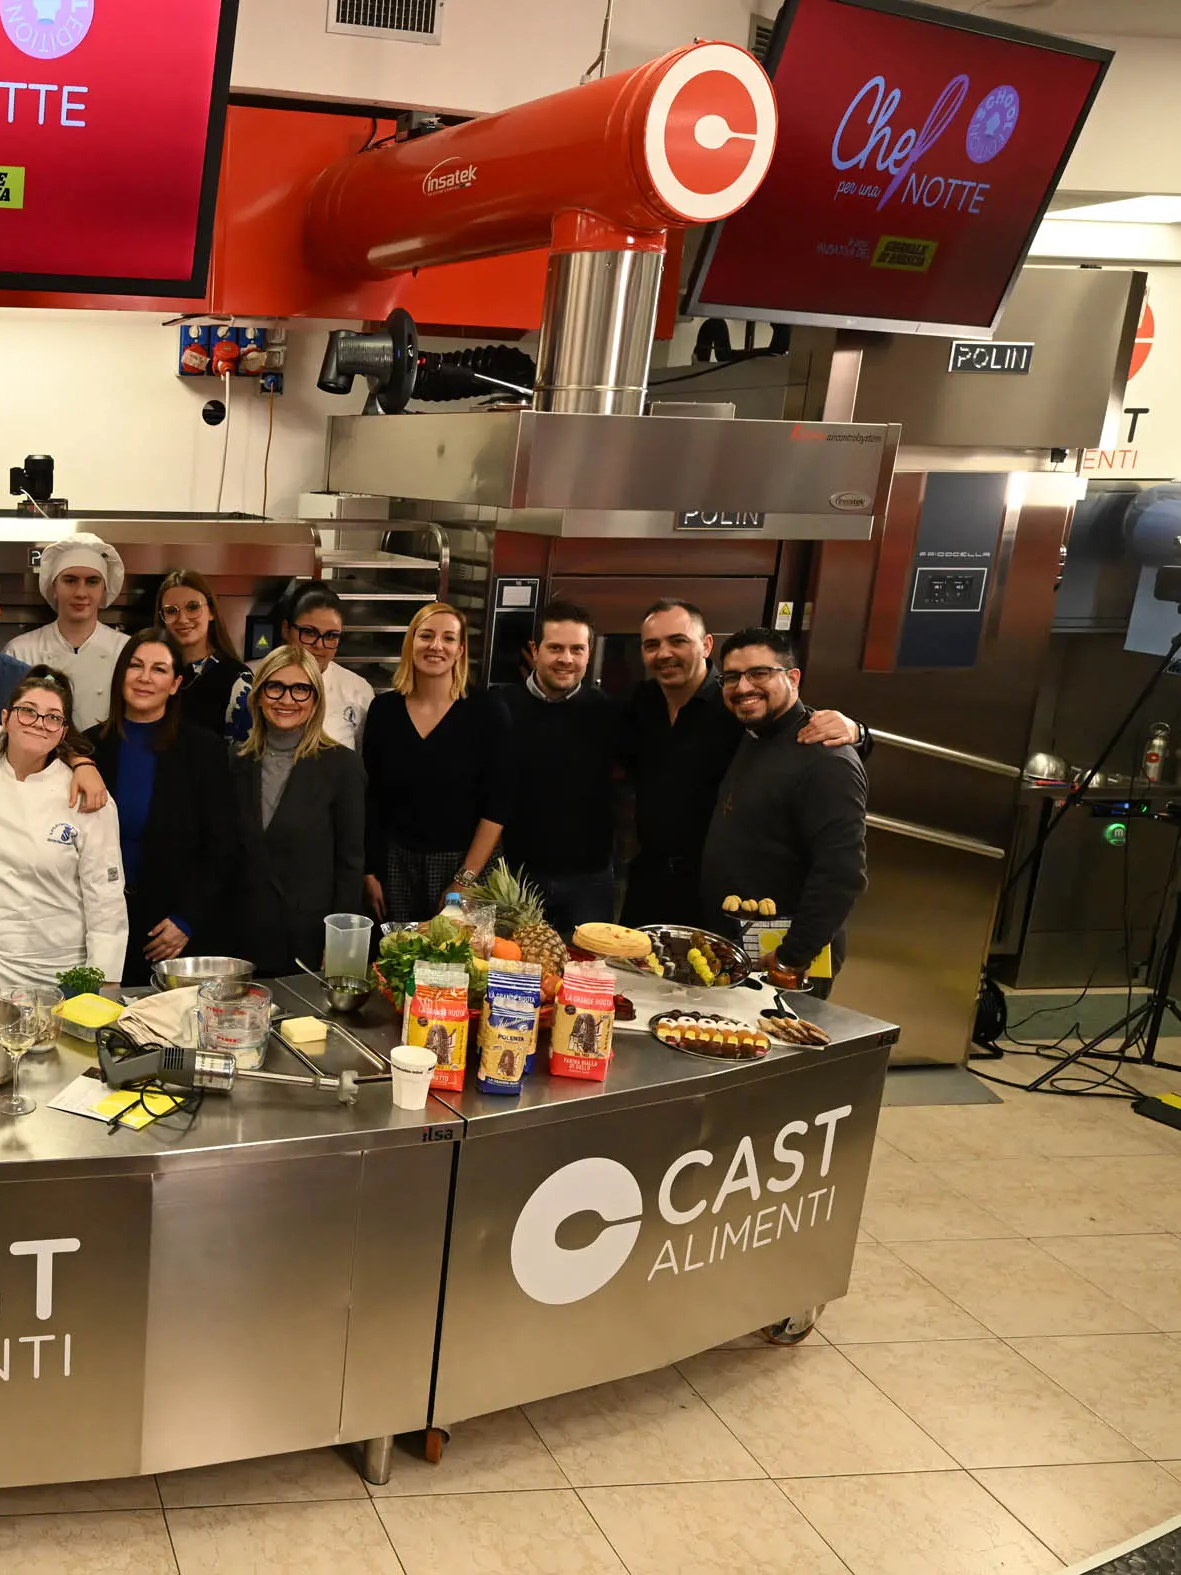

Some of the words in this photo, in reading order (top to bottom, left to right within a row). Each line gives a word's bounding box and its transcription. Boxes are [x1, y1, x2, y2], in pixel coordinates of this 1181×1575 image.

[427, 164, 478, 192] insatek
[900, 172, 991, 214] NOTTE
[957, 346, 1028, 370] POLIN
[448, 1008, 466, 1017] RUOTA
[573, 995, 594, 1005] GRANDE
[595, 999, 612, 1007] RUOTA
[498, 1033, 525, 1042] POLENTA
[423, 1127, 453, 1142] ilsa
[658, 1105, 852, 1225] CAST
[648, 1185, 835, 1282] ALIMENTI
